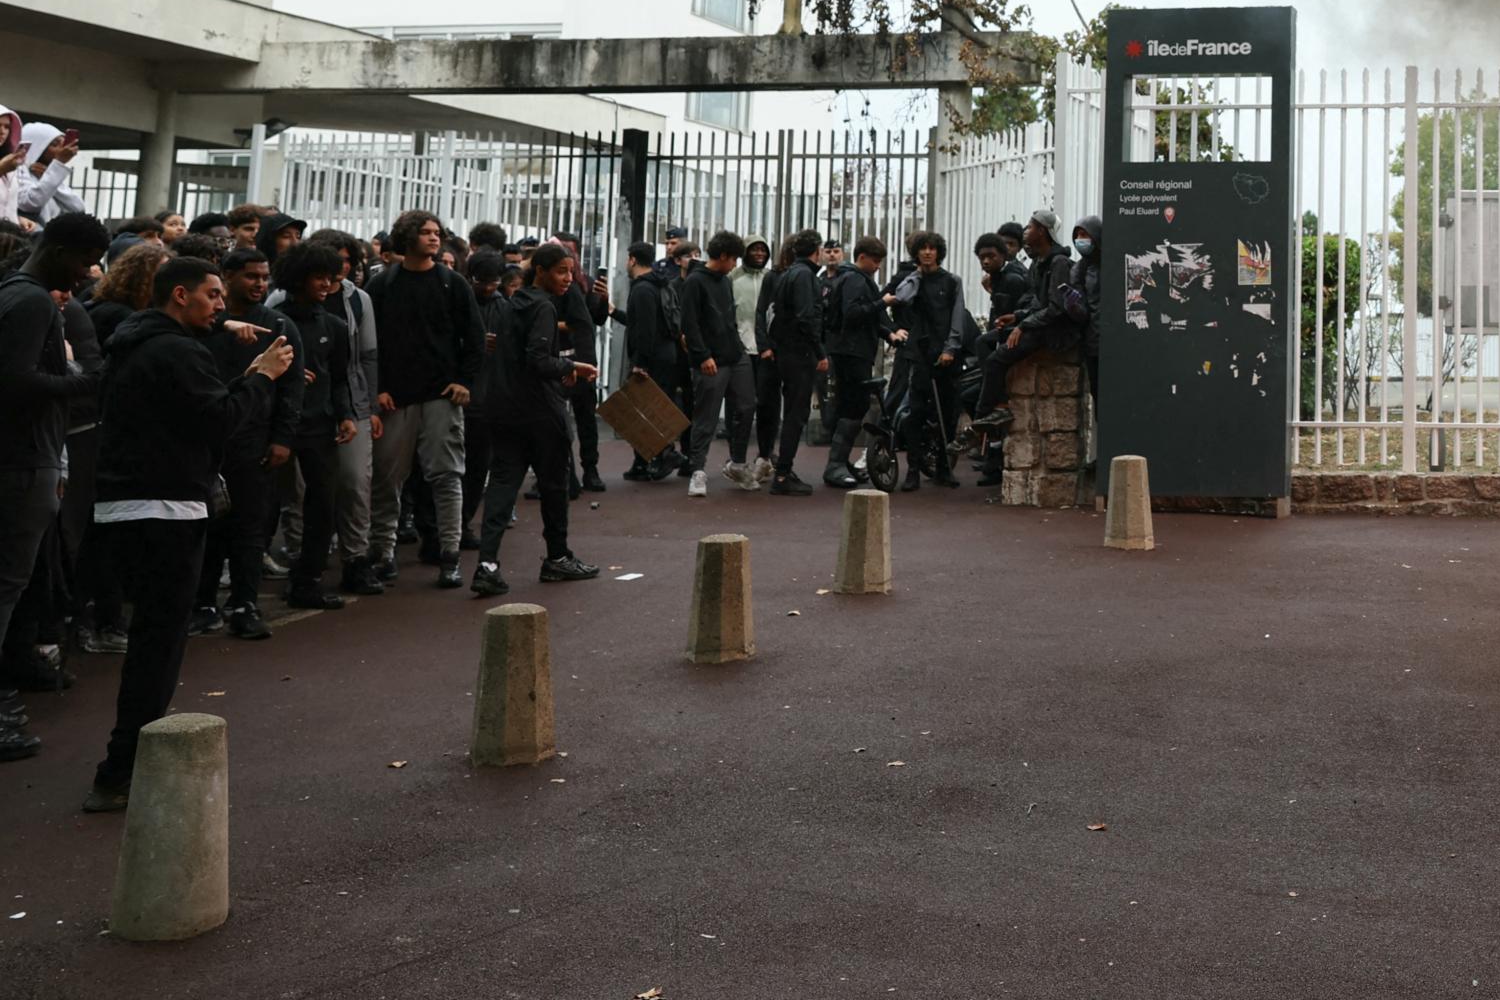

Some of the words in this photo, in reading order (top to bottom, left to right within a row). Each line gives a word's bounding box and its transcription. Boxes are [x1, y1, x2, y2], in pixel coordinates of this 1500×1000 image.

[1120, 180, 1154, 190] Conseil
[1156, 180, 1192, 191] régional
[1120, 195, 1140, 203] Lycée
[1142, 194, 1177, 203] polyvalent
[1119, 207, 1135, 215] Paul
[1136, 207, 1159, 215] Eluard
